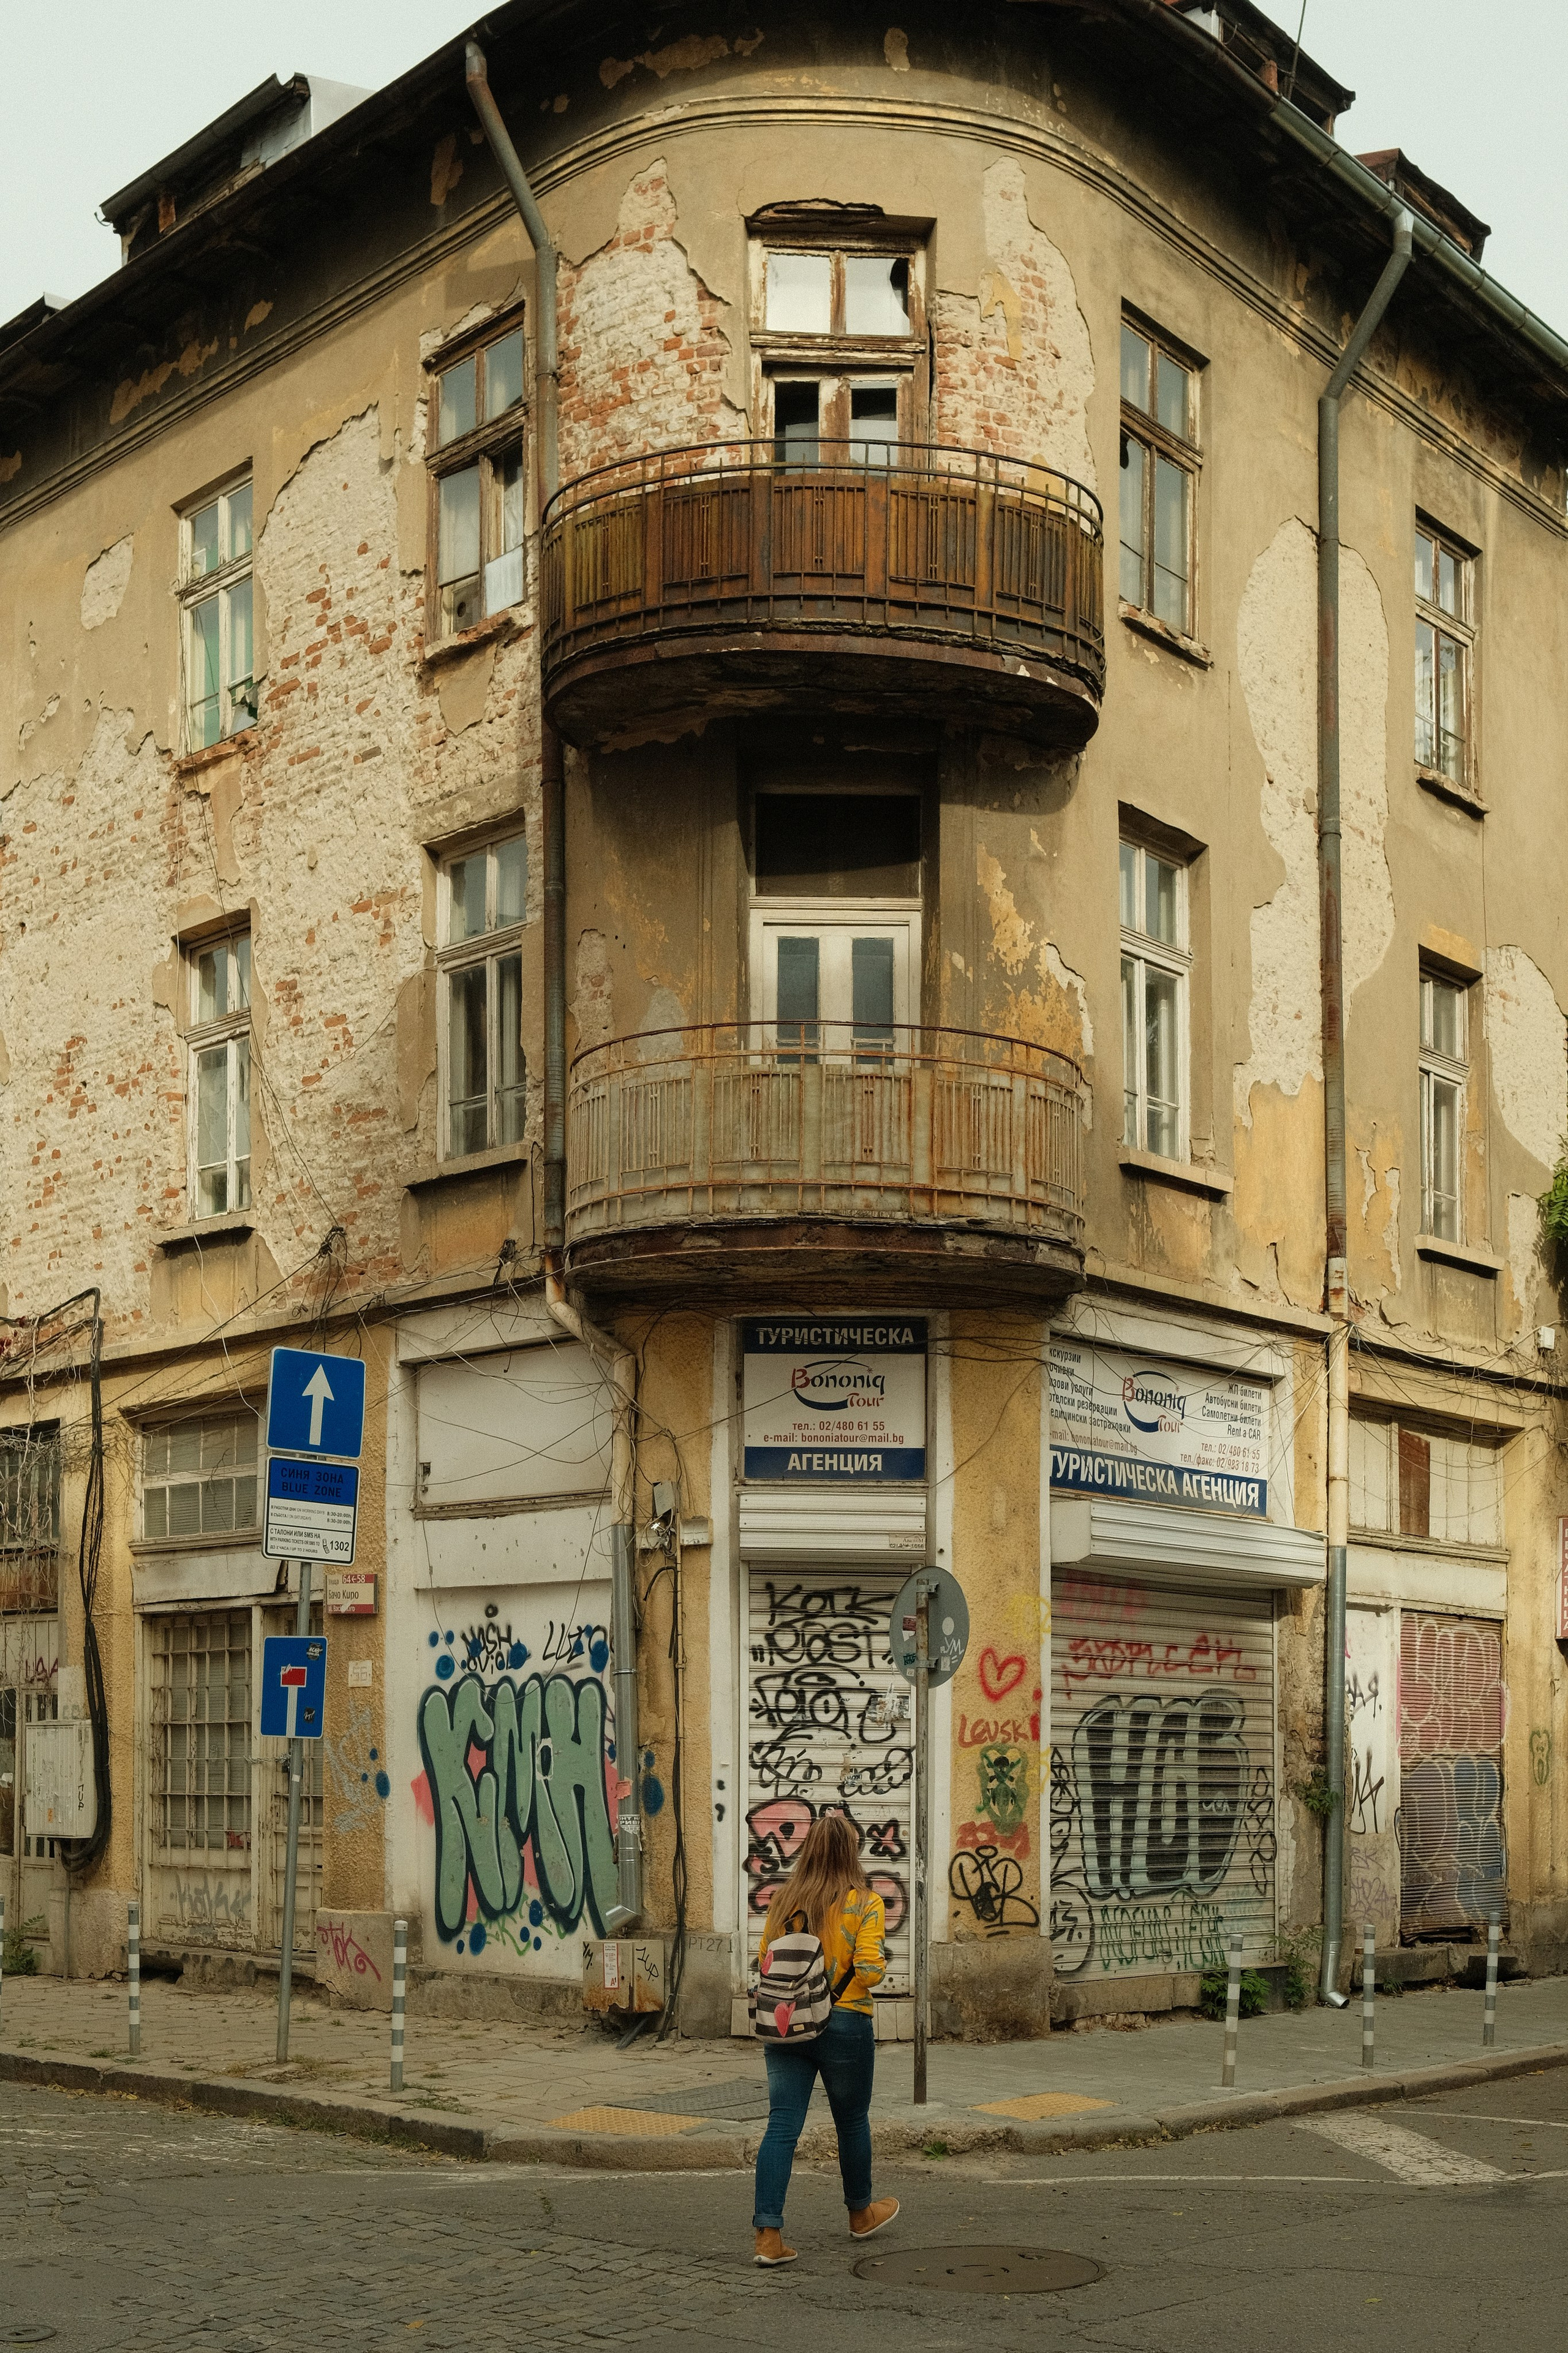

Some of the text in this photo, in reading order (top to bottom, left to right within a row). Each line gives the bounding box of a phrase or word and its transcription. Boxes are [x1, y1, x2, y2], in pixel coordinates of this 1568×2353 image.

[756, 1328, 913, 1345] ТУРИСТИЧЕСКА
[846, 1392, 884, 1407] Tour
[1227, 1383, 1262, 1400] ЖП билети
[1077, 1402, 1117, 1416] резервации
[1205, 1392, 1261, 1413] Автобусни билети
[1158, 1414, 1183, 1433] Tour
[1202, 1405, 1261, 1427] Самолетни билети
[819, 1421, 854, 1431] 02/480
[858, 1421, 869, 1430] 61
[873, 1421, 885, 1430] 55
[1089, 1416, 1131, 1433] застраховки
[1227, 1424, 1242, 1437] Rent
[1248, 1428, 1261, 1440] CAR
[763, 1433, 904, 1445] e-mail: bononiatour@mail.bg
[1201, 1443, 1216, 1452] тел.:
[1218, 1443, 1241, 1457] 02/480
[788, 1453, 882, 1474] АГЕНЦИЯ
[281, 1467, 343, 1484] СИНЯ ЗОНА
[1049, 1450, 1259, 1508] ТУРИСТИЧЕСКА АГЕНЦИЯ
[282, 1481, 341, 1497] BLUE ZONE
[330, 1540, 350, 1551] 1302
[343, 1574, 365, 1583] 64 58
[328, 1590, 341, 1599] Бачо
